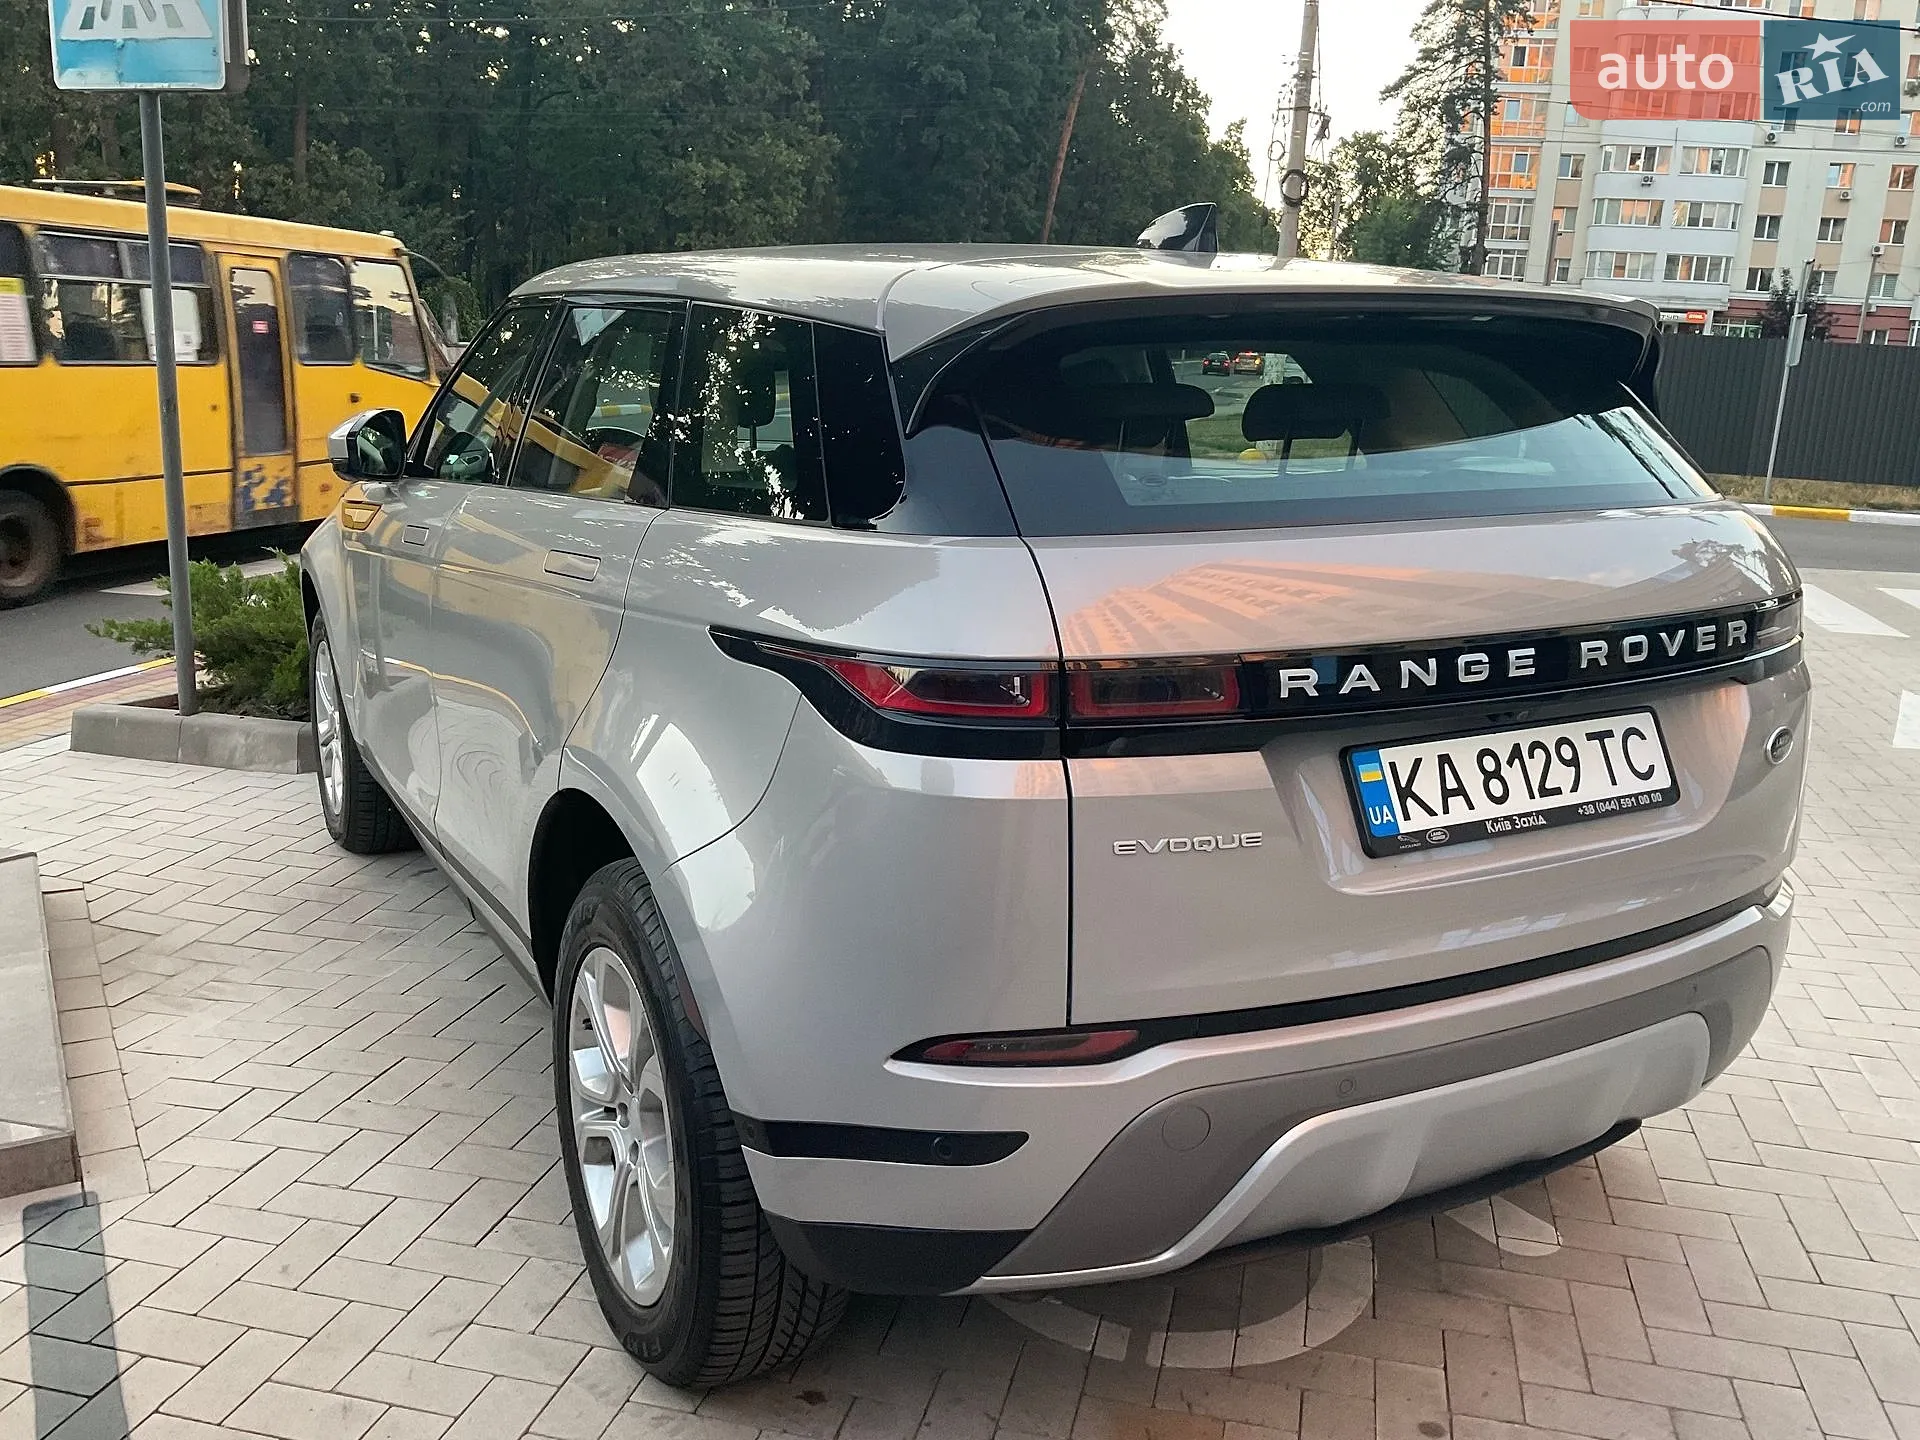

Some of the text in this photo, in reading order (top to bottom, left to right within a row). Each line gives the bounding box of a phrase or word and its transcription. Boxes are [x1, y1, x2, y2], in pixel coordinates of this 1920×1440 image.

[1279, 619, 1748, 699] RANGE ROVER
[1387, 726, 1655, 822] KA 8129 TC
[1369, 804, 1394, 825] UA
[1578, 792, 1663, 815] +38 (044) 591 00 00
[1485, 812, 1547, 834] Київ Захід
[1113, 832, 1263, 855] EVOQUE
